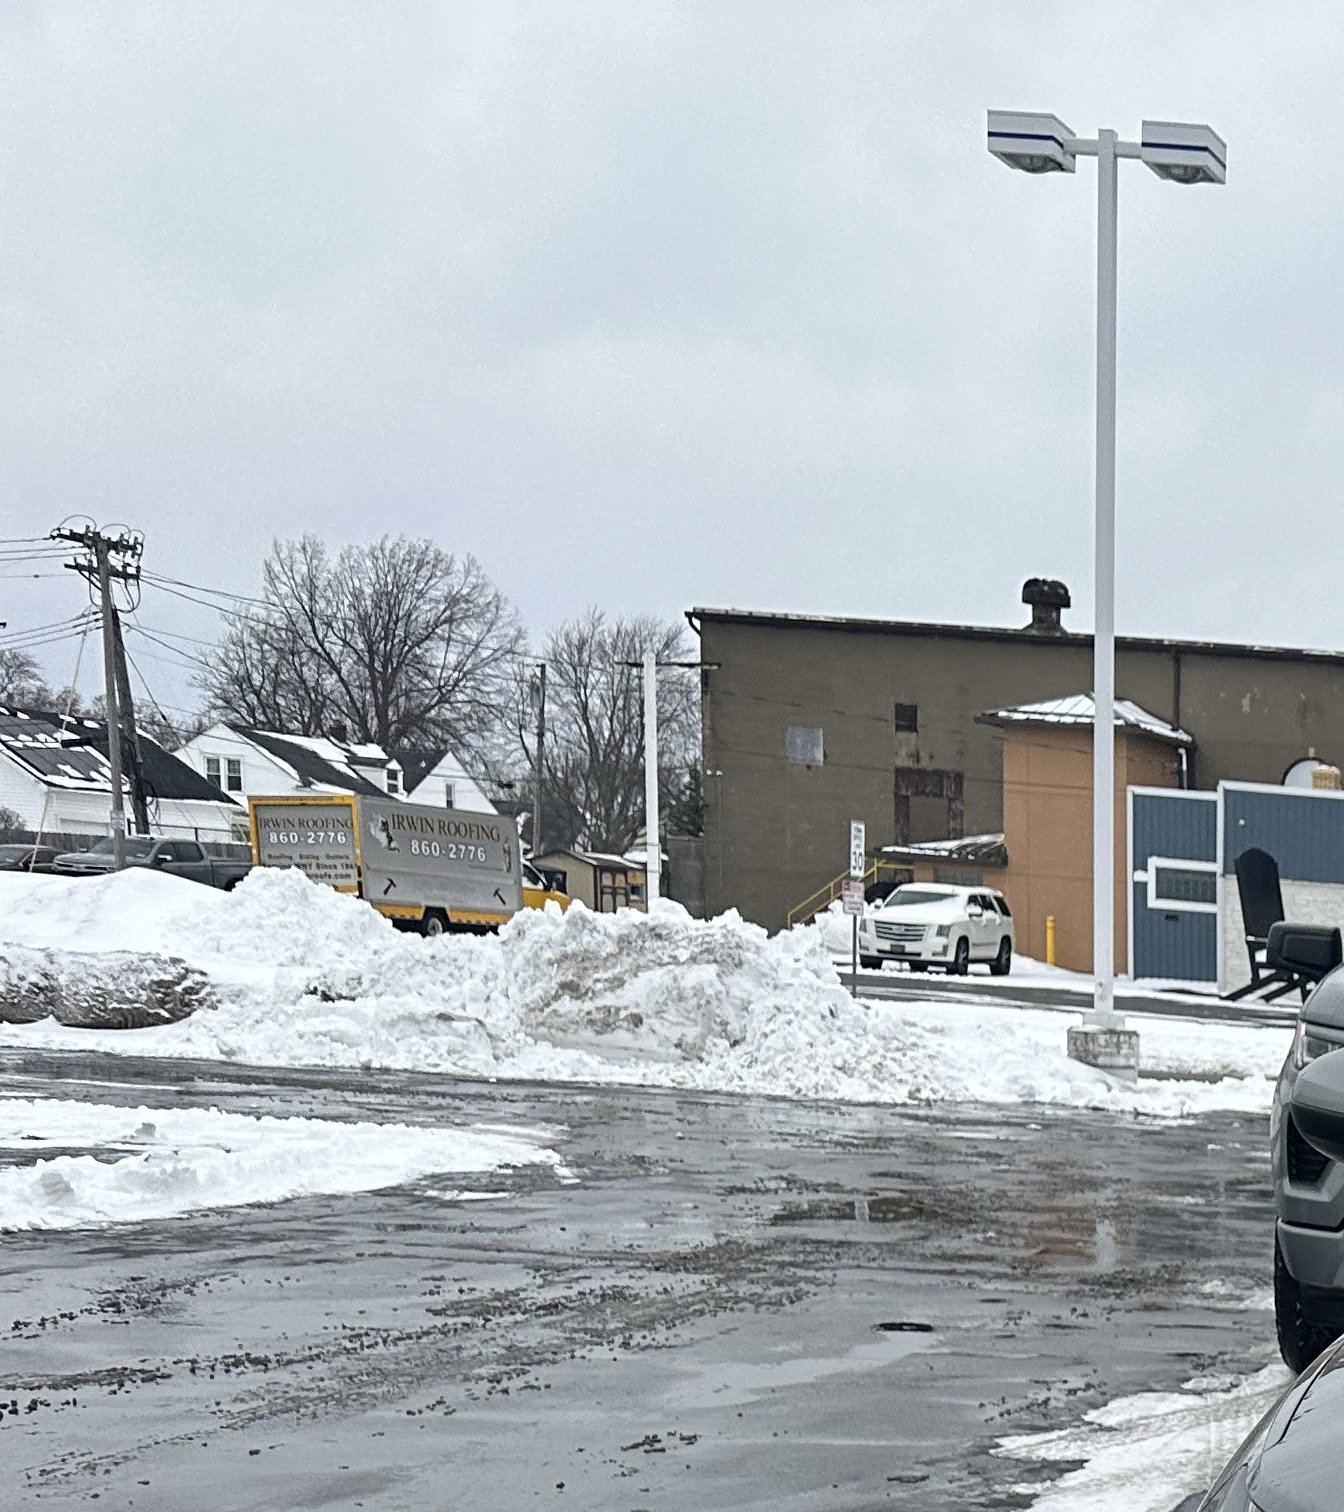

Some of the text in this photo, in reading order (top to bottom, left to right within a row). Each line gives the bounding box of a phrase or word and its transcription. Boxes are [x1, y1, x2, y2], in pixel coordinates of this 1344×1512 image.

[259, 817, 296, 829] IRWIN
[391, 813, 500, 842] IRWIN ROOFING
[269, 831, 346, 844] 860-2776
[410, 839, 486, 863] 860-2776
